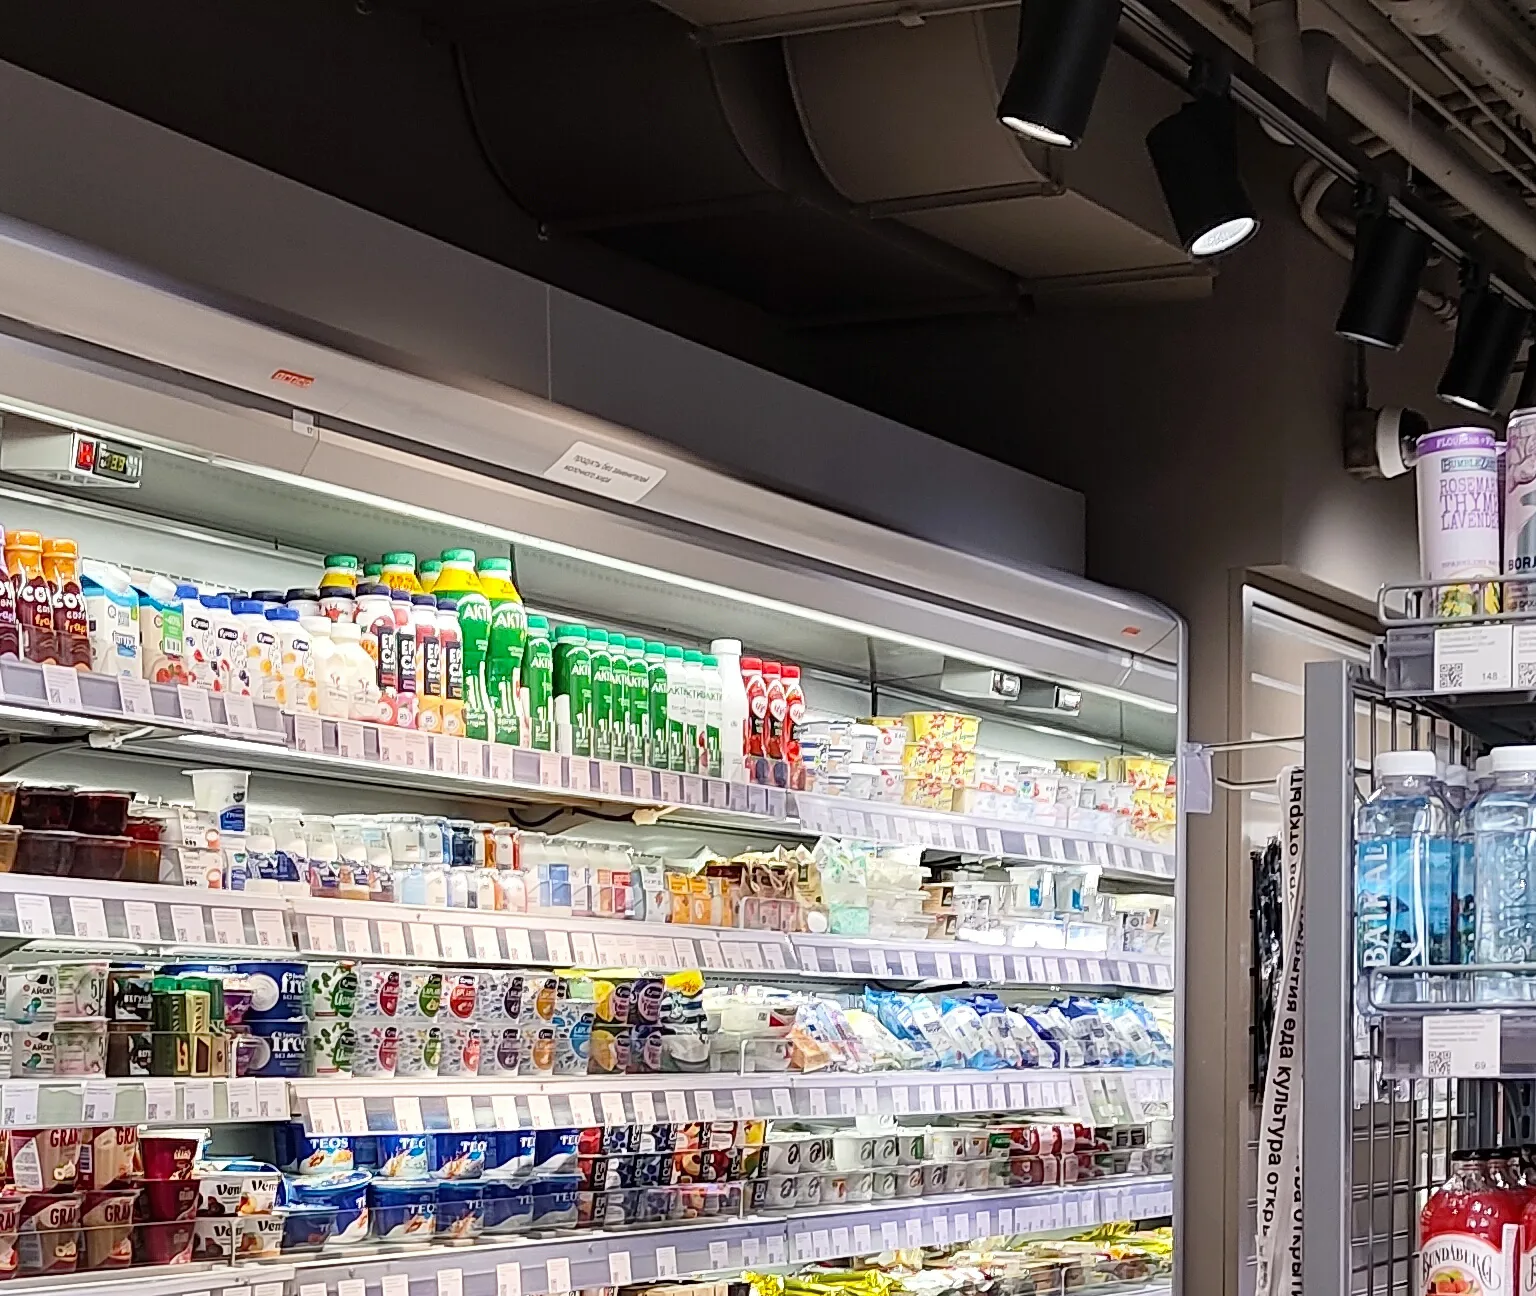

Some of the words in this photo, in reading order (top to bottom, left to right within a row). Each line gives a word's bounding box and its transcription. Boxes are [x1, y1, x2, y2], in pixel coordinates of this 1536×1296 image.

[1364, 843, 1388, 968] BAIKAL
[1279, 1018, 1298, 1059] еда
[1474, 1061, 1486, 1070] 69
[1265, 1065, 1295, 1167] культура
[310, 1136, 349, 1150] TEOS
